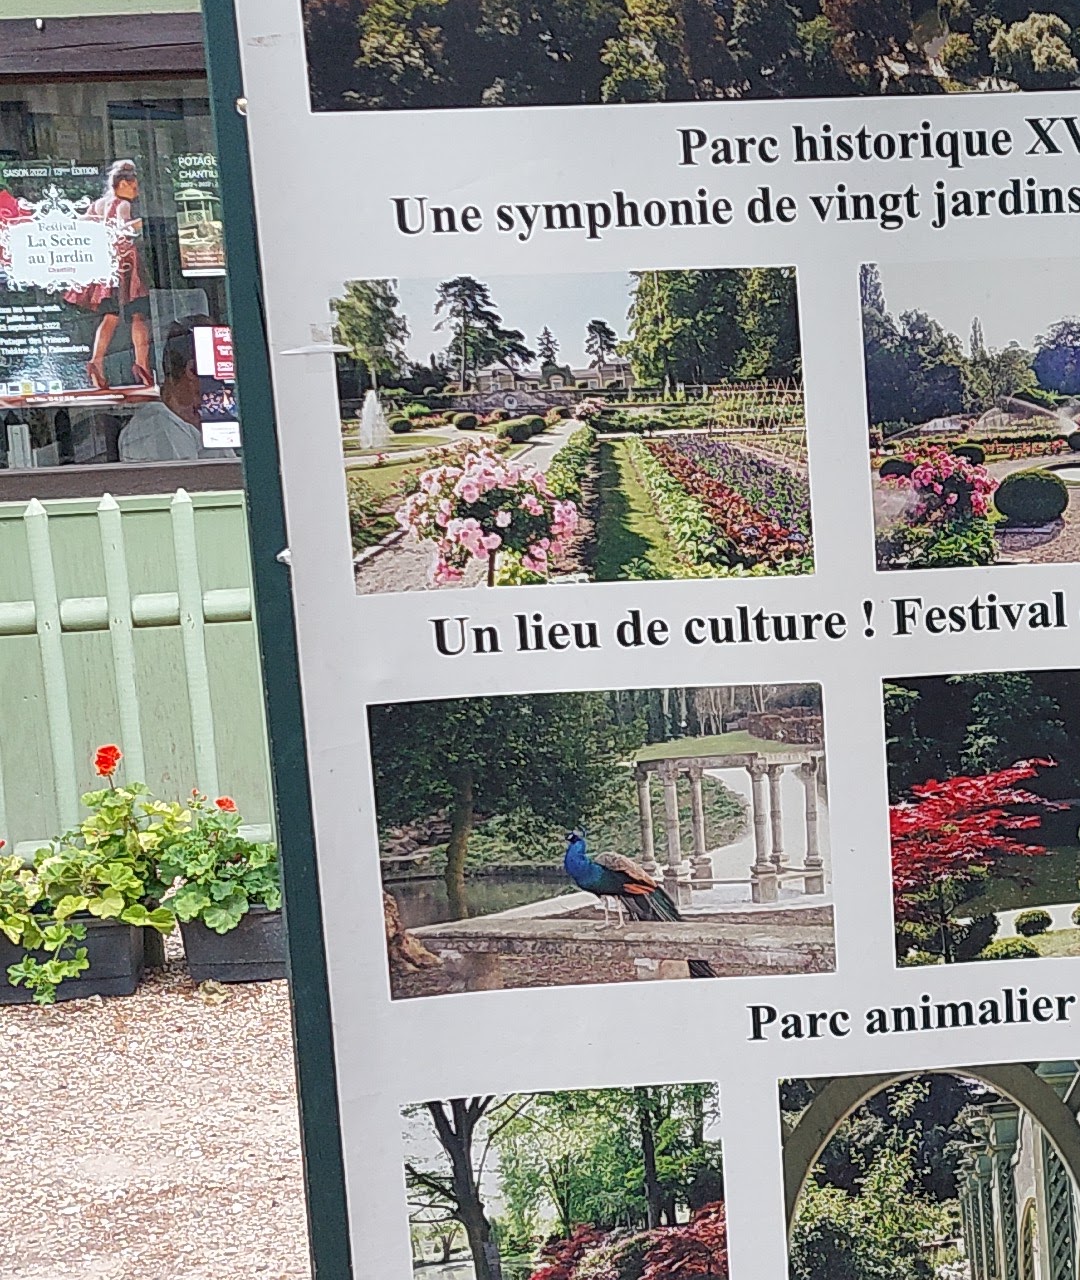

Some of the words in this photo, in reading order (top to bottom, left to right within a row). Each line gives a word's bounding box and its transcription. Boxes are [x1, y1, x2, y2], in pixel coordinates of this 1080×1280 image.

[677, 128, 779, 166] Parc
[792, 120, 1012, 169] historique
[38, 222, 77, 232] Festival
[391, 197, 481, 235] Une
[496, 188, 732, 242] symphonie
[747, 186, 797, 224] de
[809, 183, 921, 231] vingt
[28, 235, 47, 247] La
[50, 234, 91, 247] Scène
[28, 254, 45, 264] au
[49, 250, 93, 266] Jardin
[429, 617, 501, 656] Un
[515, 613, 600, 651] lieu
[616, 609, 669, 648] de
[684, 606, 846, 645] culture
[863, 600, 875, 638] !
[890, 591, 1067, 636] Festival
[747, 1004, 851, 1041] Parc
[865, 987, 1076, 1035] animalier
